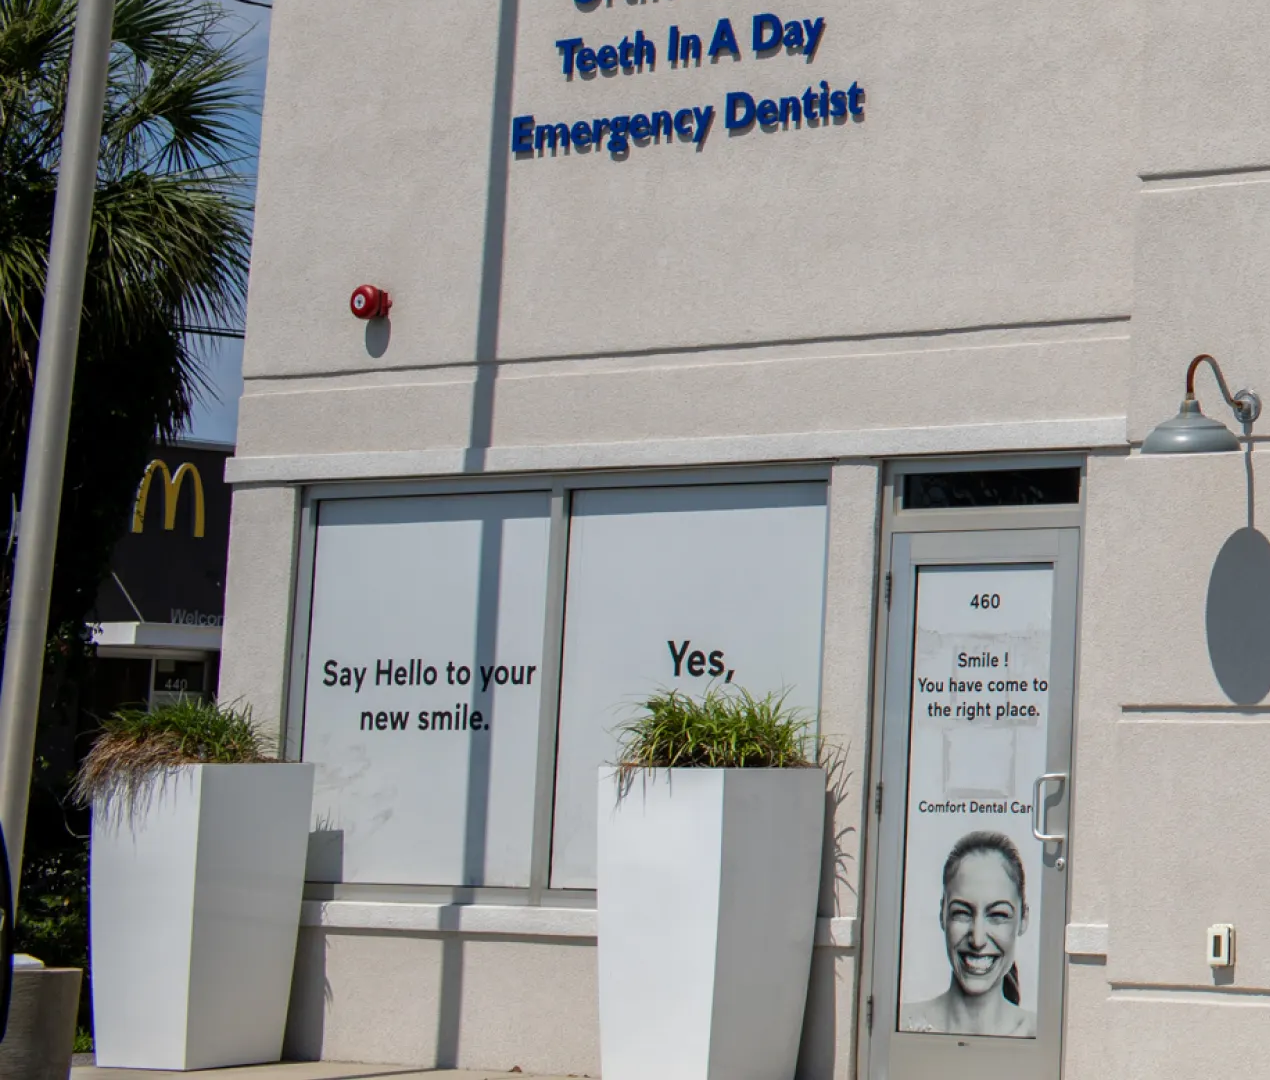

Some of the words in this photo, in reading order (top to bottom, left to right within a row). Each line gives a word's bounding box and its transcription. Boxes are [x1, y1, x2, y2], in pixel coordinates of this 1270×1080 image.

[555, 29, 655, 75] Teeth
[667, 24, 699, 62] In
[707, 17, 739, 57] A
[751, 12, 825, 56] Day
[511, 104, 714, 154] Emergency
[724, 79, 865, 130] Dentist
[970, 594, 1001, 609] 460
[667, 640, 735, 683] Yes,
[958, 652, 999, 668] Smile
[165, 678, 188, 691] 440
[322, 659, 367, 693] Say
[375, 658, 438, 686] Hello
[446, 661, 471, 685] to
[480, 662, 537, 693] your
[918, 678, 944, 693] You
[949, 678, 982, 692] have
[987, 681, 1028, 692] come
[1033, 678, 1048, 691] to
[360, 707, 410, 731] new
[417, 703, 490, 731] smile.
[928, 703, 951, 717] the
[956, 702, 991, 720] right
[996, 702, 1041, 720] place.
[918, 801, 966, 813] Comfort
[970, 801, 1007, 813] Dental
